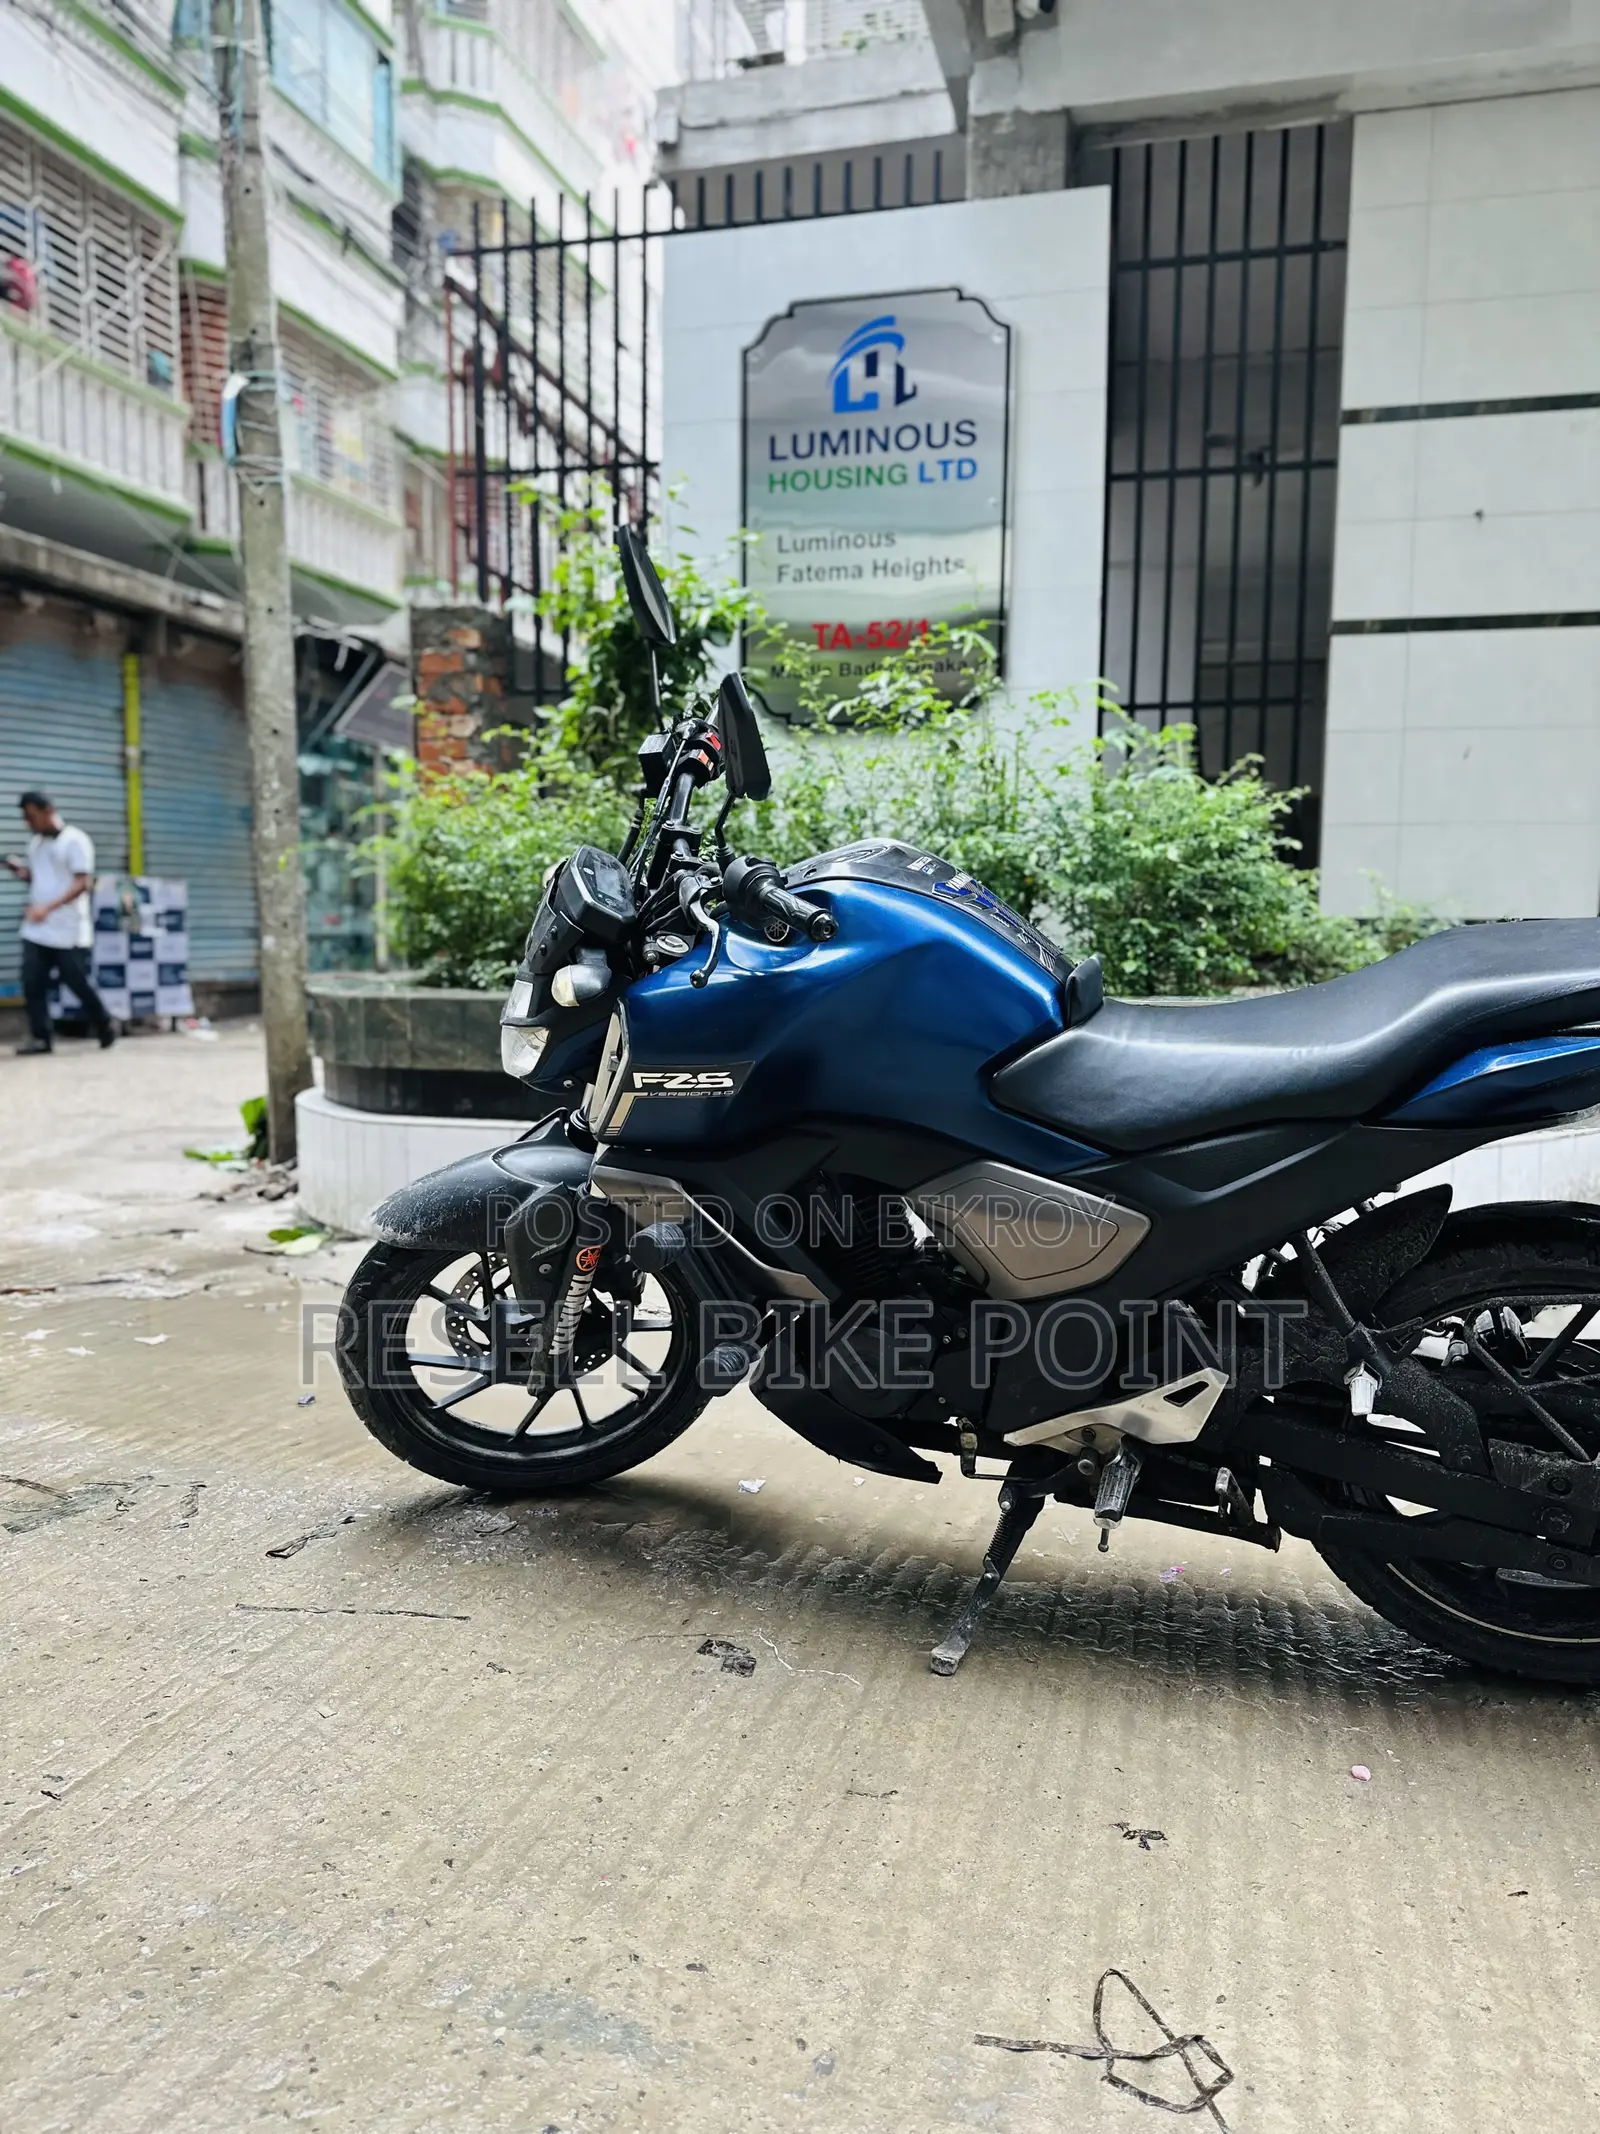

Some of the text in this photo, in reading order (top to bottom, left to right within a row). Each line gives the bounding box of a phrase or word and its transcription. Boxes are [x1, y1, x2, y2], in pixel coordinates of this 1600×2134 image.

[768, 419, 978, 461] LUMINOUS
[768, 457, 978, 493] HOUSING LTD
[777, 530, 897, 554] Luminous
[777, 555, 965, 585] Fatema Heights
[548, 1268, 597, 1355] YAMAHA
